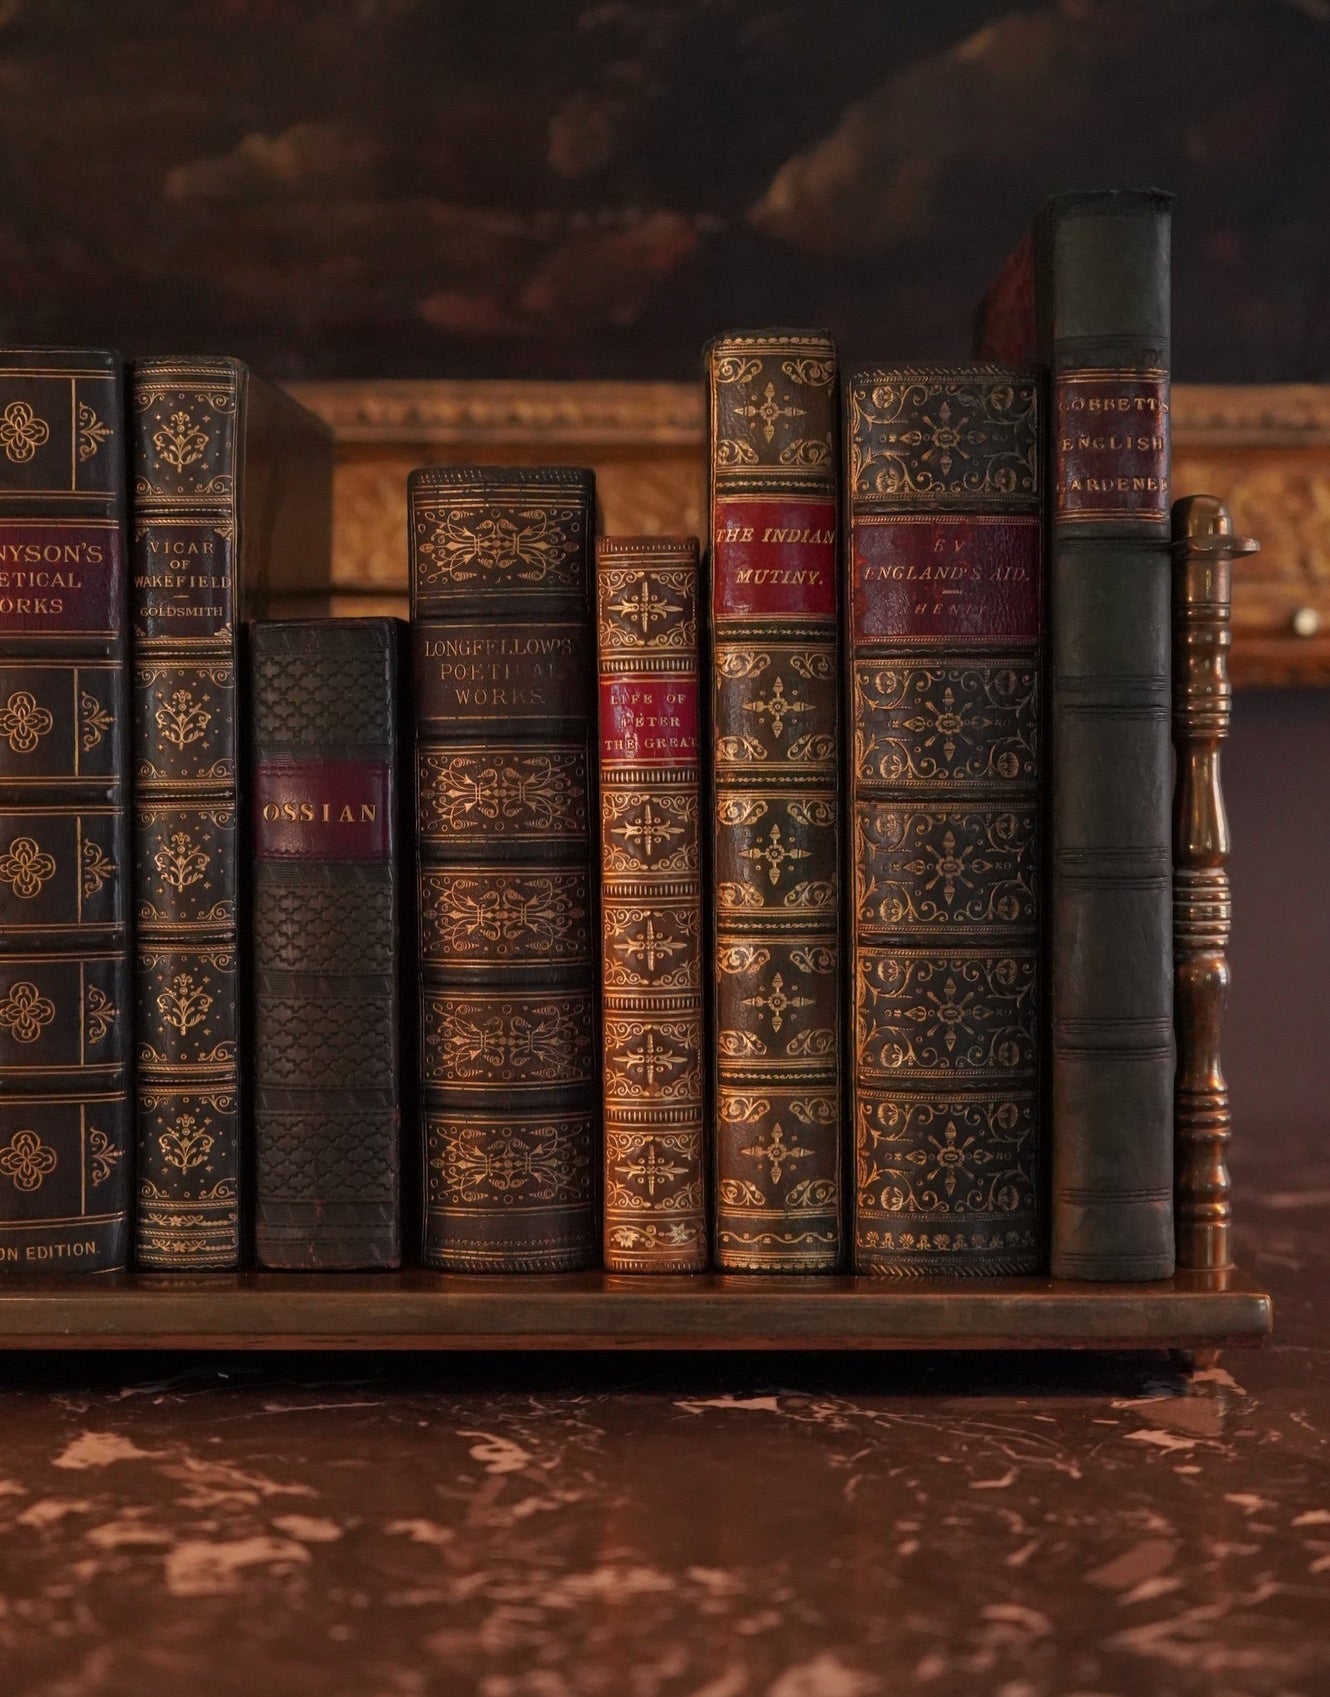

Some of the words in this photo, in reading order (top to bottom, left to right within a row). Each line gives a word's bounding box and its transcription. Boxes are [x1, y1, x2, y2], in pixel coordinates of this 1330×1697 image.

[1061, 437, 1164, 452] ENGLISH
[716, 527, 754, 543] THE
[761, 527, 836, 544] INDIAN
[150, 541, 215, 554] VICAR
[169, 559, 191, 570] OF
[735, 568, 824, 585] MUTINY.
[863, 566, 983, 581] ENGLAND'S
[135, 574, 232, 589] WAKEFIELD
[0, 598, 64, 614] ORKS
[140, 606, 223, 617] GOLDSMITH
[424, 638, 573, 657] LONGFELLOW'S
[610, 694, 653, 705] LIFE
[666, 693, 686, 704] OF
[622, 716, 681, 728] PETER
[605, 740, 635, 750] THE
[263, 803, 377, 822] OSSIAN
[26, 1241, 101, 1260] EDITION.
